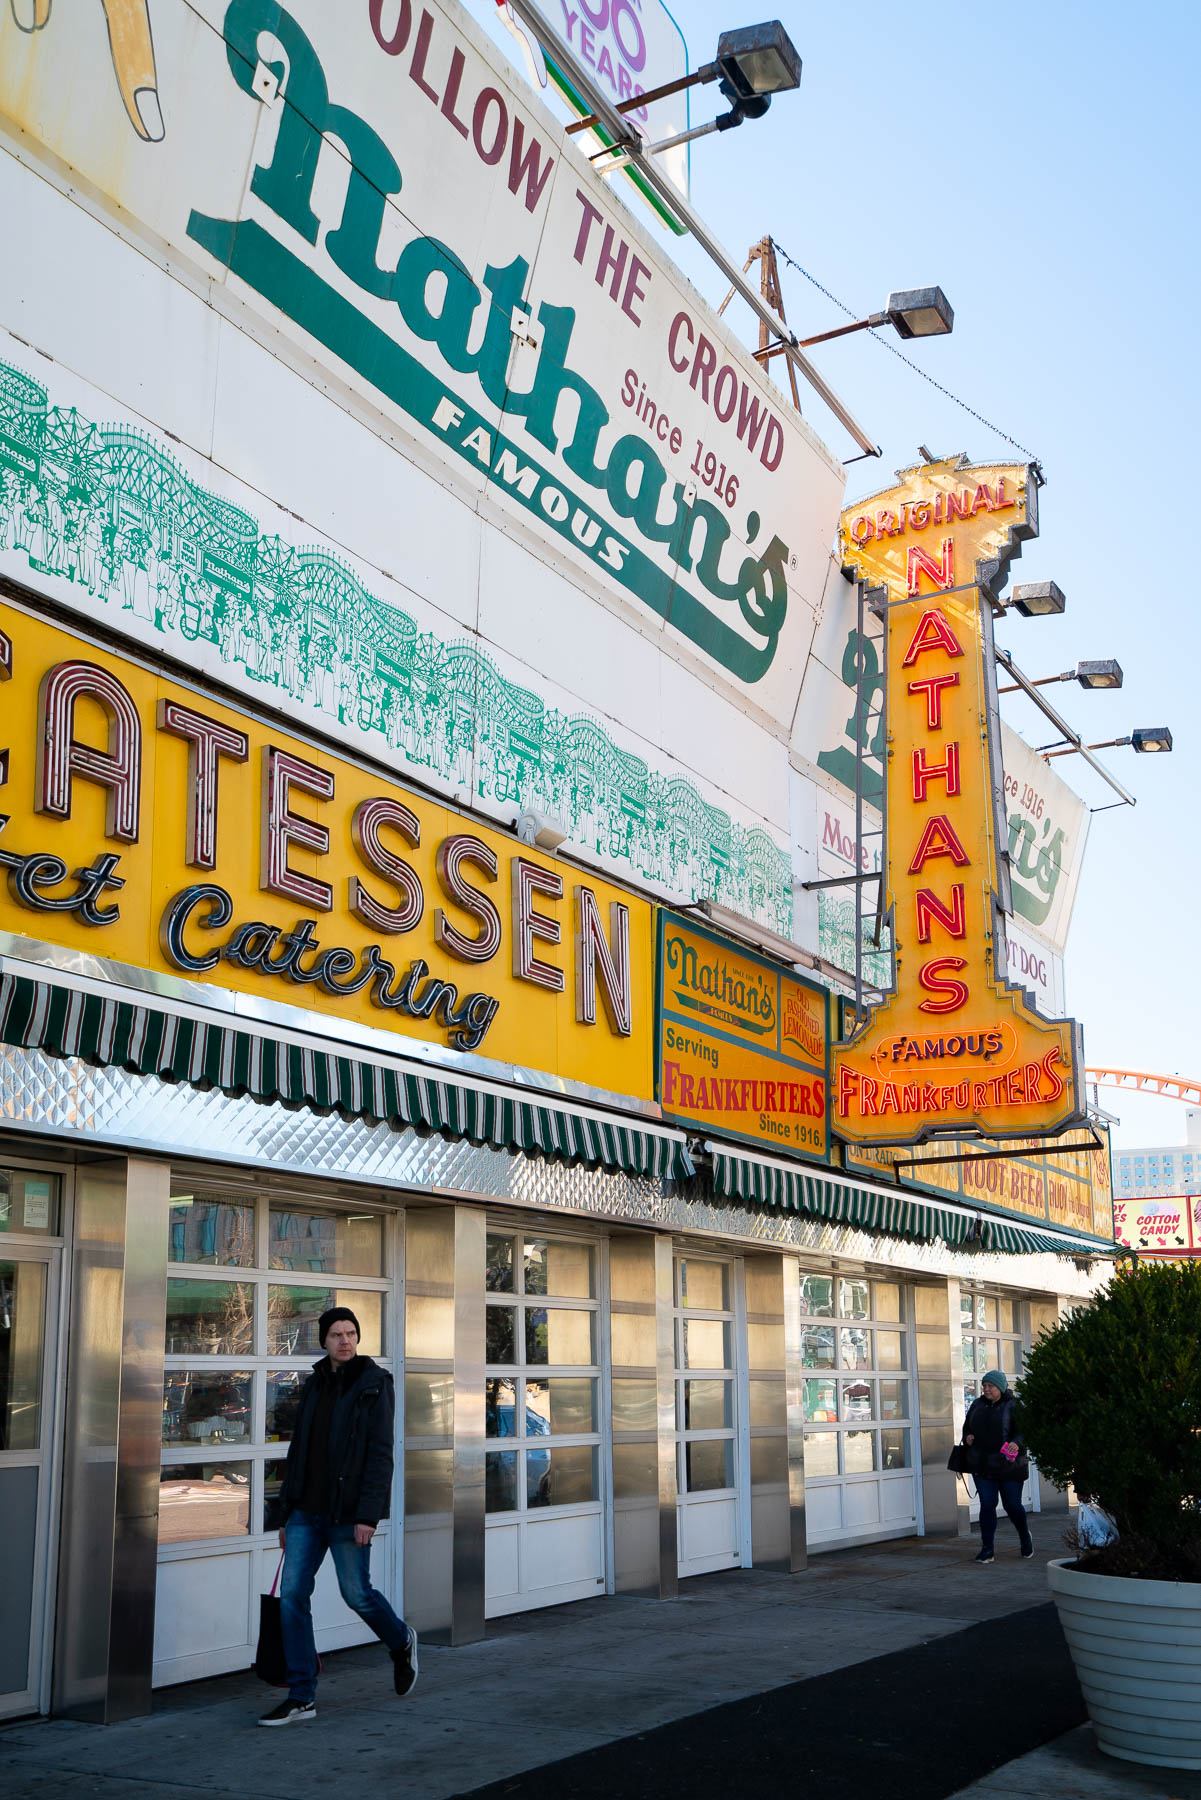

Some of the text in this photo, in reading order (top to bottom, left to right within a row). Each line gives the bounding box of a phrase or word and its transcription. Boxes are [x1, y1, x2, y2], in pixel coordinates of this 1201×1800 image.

[577, 189, 652, 328] THE
[668, 311, 784, 472] CROWD
[620, 368, 740, 508] Since 1916
[431, 395, 631, 571] FAMOUS
[851, 476, 1015, 546] ORIGINAL
[902, 537, 971, 1015] NATHANS
[1020, 783, 1045, 820] 1916
[0, 630, 632, 1038] ATESSEN
[0, 815, 127, 927] et
[159, 883, 501, 1052] Catering
[1020, 945, 1047, 987] DOG
[666, 1027, 719, 1069] Serving
[784, 1012, 824, 1056] LEMONADE
[891, 1032, 1003, 1064] FAMOUS
[663, 1059, 826, 1118] FRANKFURTERS
[839, 1046, 1063, 1118] FRANKFURTERS
[759, 1112, 823, 1148] Since 1916.
[963, 1151, 1007, 1196] ROOT
[1010, 1167, 1044, 1209] BEER
[1136, 1213, 1181, 1226] COTTON
[1139, 1224, 1180, 1236] CANDY
